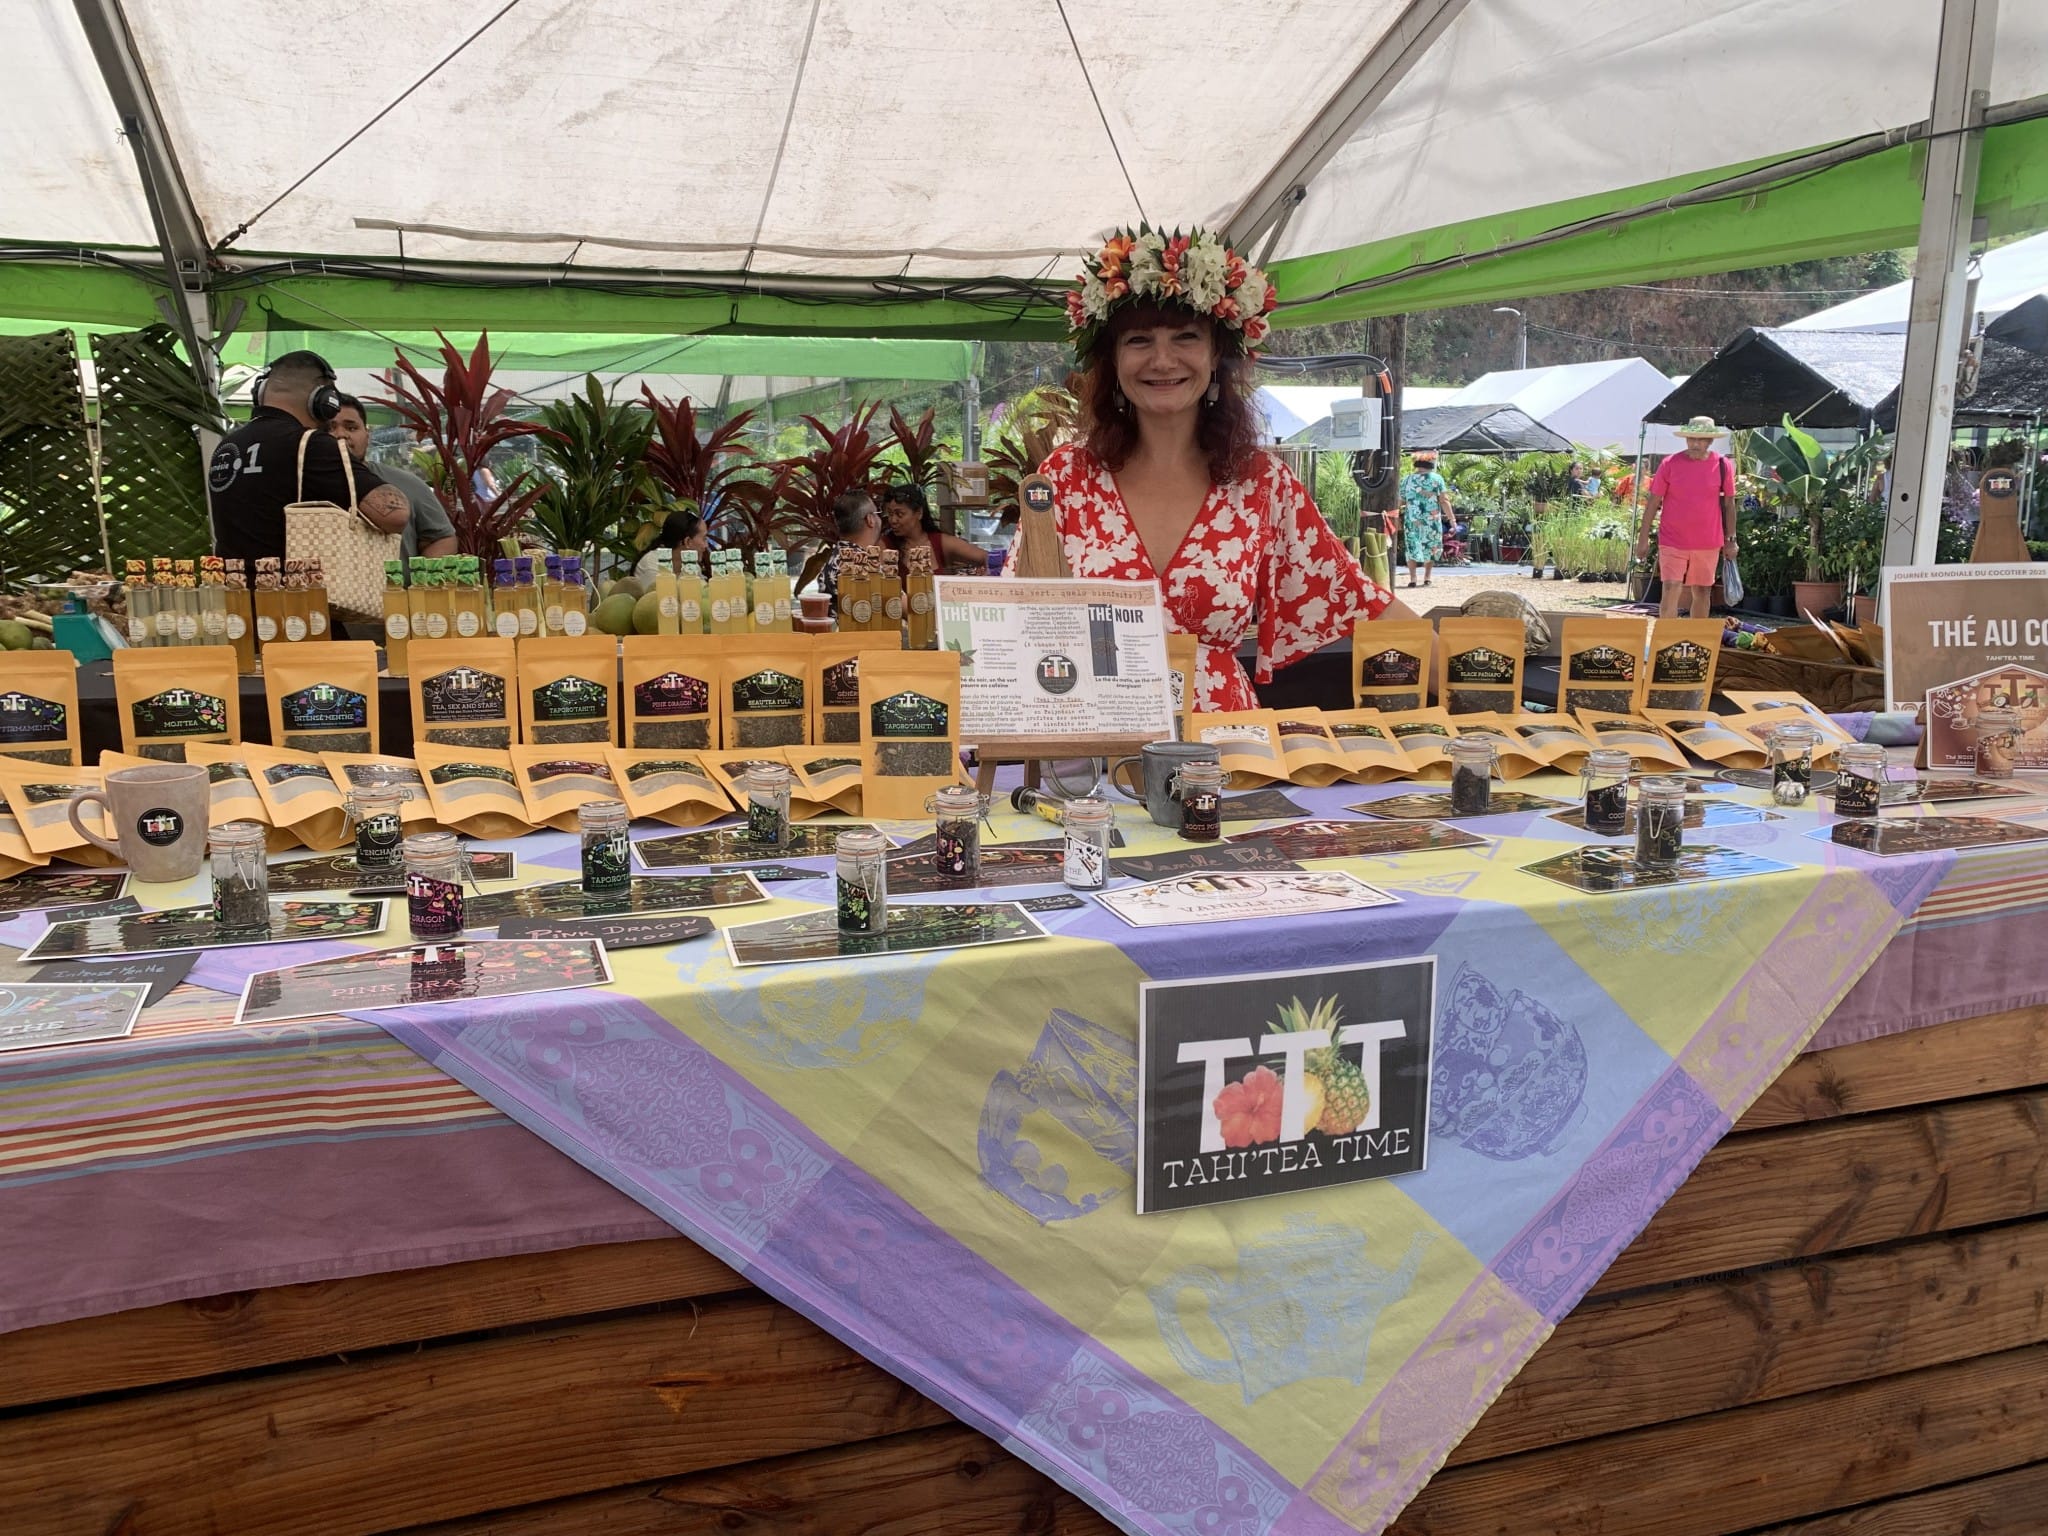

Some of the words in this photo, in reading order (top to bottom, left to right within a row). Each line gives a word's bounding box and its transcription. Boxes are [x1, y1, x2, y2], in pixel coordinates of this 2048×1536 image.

[1894, 572, 1928, 580] JOURNÉE
[1931, 570, 1972, 578] MONDIALE
[942, 603, 969, 621] THÉ
[972, 606, 1006, 622] VERT
[1088, 604, 1112, 621] THÉ
[1115, 607, 1144, 623] NOIR
[1927, 614, 1977, 648] THÉ
[1984, 619, 2018, 647] AU
[1041, 656, 1071, 678] TTT
[449, 670, 478, 689] TTT
[562, 678, 582, 690] TTT
[662, 674, 683, 689] TTT
[760, 670, 780, 685] TTT
[166, 690, 191, 706] TTT
[312, 685, 336, 701] TTT
[1983, 674, 2045, 708] TTT
[898, 693, 920, 707] TTT
[1195, 794, 1217, 810] TTT
[143, 816, 177, 833] TTT
[373, 816, 397, 833] TTT
[1178, 875, 1254, 891] TTT
[411, 915, 446, 923] DRAGON
[601, 918, 699, 935] DRAGON
[331, 983, 397, 997] PINK
[405, 973, 517, 990] DRAGON
[1177, 1019, 1407, 1154] TTT
